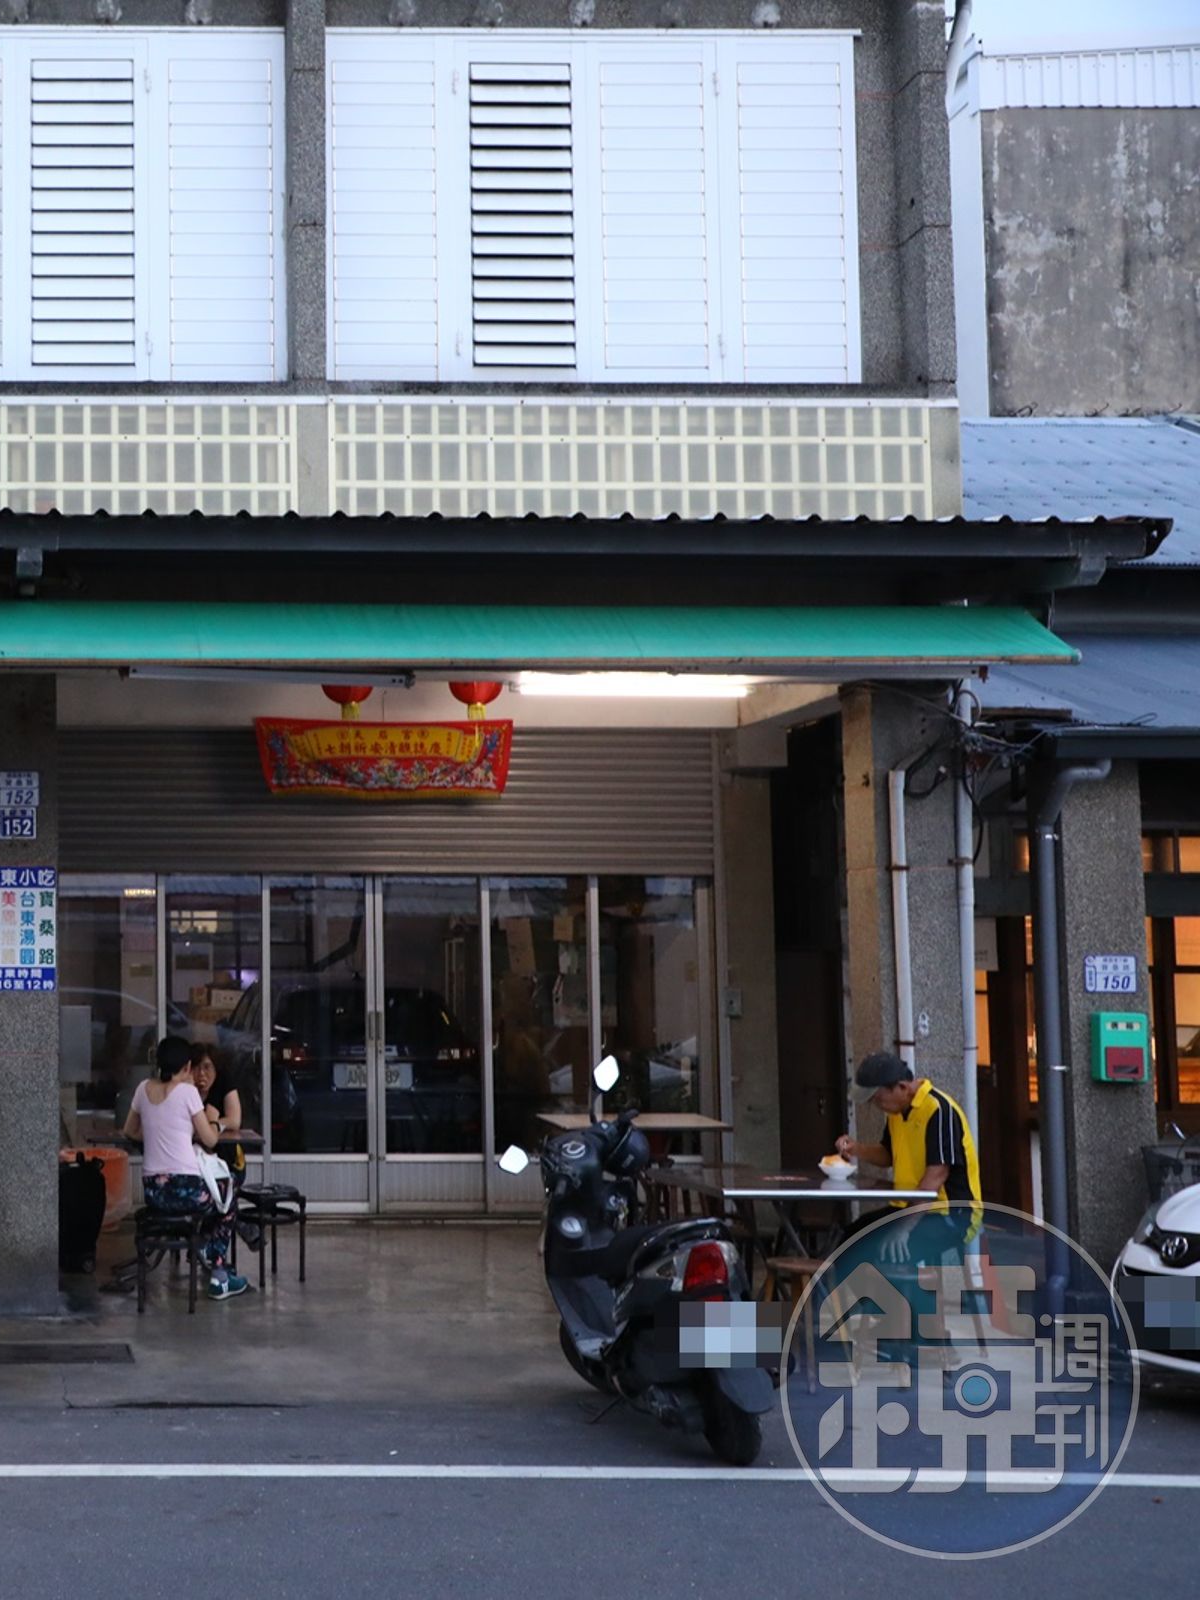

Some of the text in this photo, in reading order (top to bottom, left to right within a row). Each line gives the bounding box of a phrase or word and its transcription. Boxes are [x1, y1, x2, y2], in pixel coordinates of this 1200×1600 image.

[5, 790, 34, 804] 152
[4, 818, 33, 836] 152
[19, 890, 36, 966] 台東湯圓
[38, 890, 55, 966] 寶桑路
[1103, 975, 1131, 990] 150
